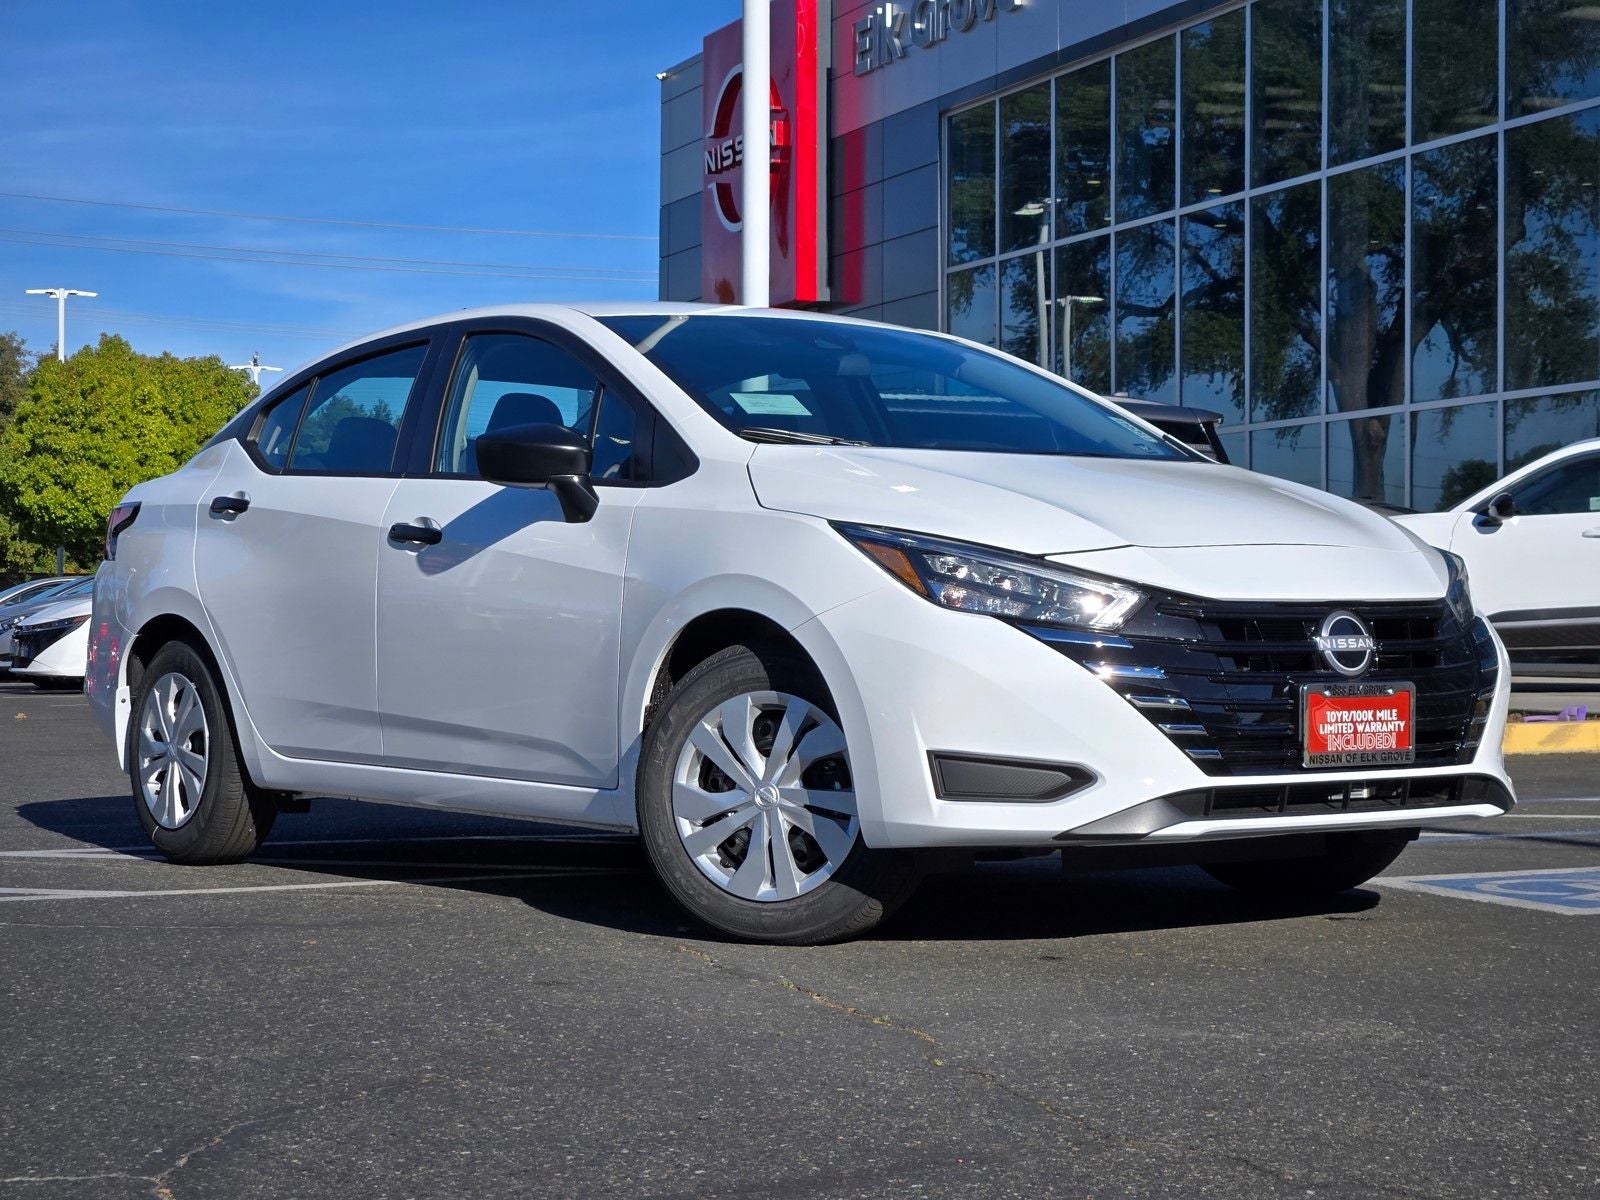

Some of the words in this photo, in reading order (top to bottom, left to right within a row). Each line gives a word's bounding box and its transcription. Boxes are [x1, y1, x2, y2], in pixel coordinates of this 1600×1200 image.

[854, 2, 906, 76] Elk
[910, 0, 1024, 49] Gro
[1319, 637, 1374, 649] NISSAN
[1326, 710, 1374, 722] 10YR/100K
[1376, 709, 1398, 721] MILE
[1319, 722, 1354, 734] LIMITED
[1356, 721, 1406, 733] WARRANTY
[1327, 733, 1397, 751] INCLUDED!
[1309, 754, 1342, 765] NISSAN
[1345, 753, 1358, 763] OF
[1361, 752, 1378, 762] ELK
[1380, 751, 1411, 761] GROVE
